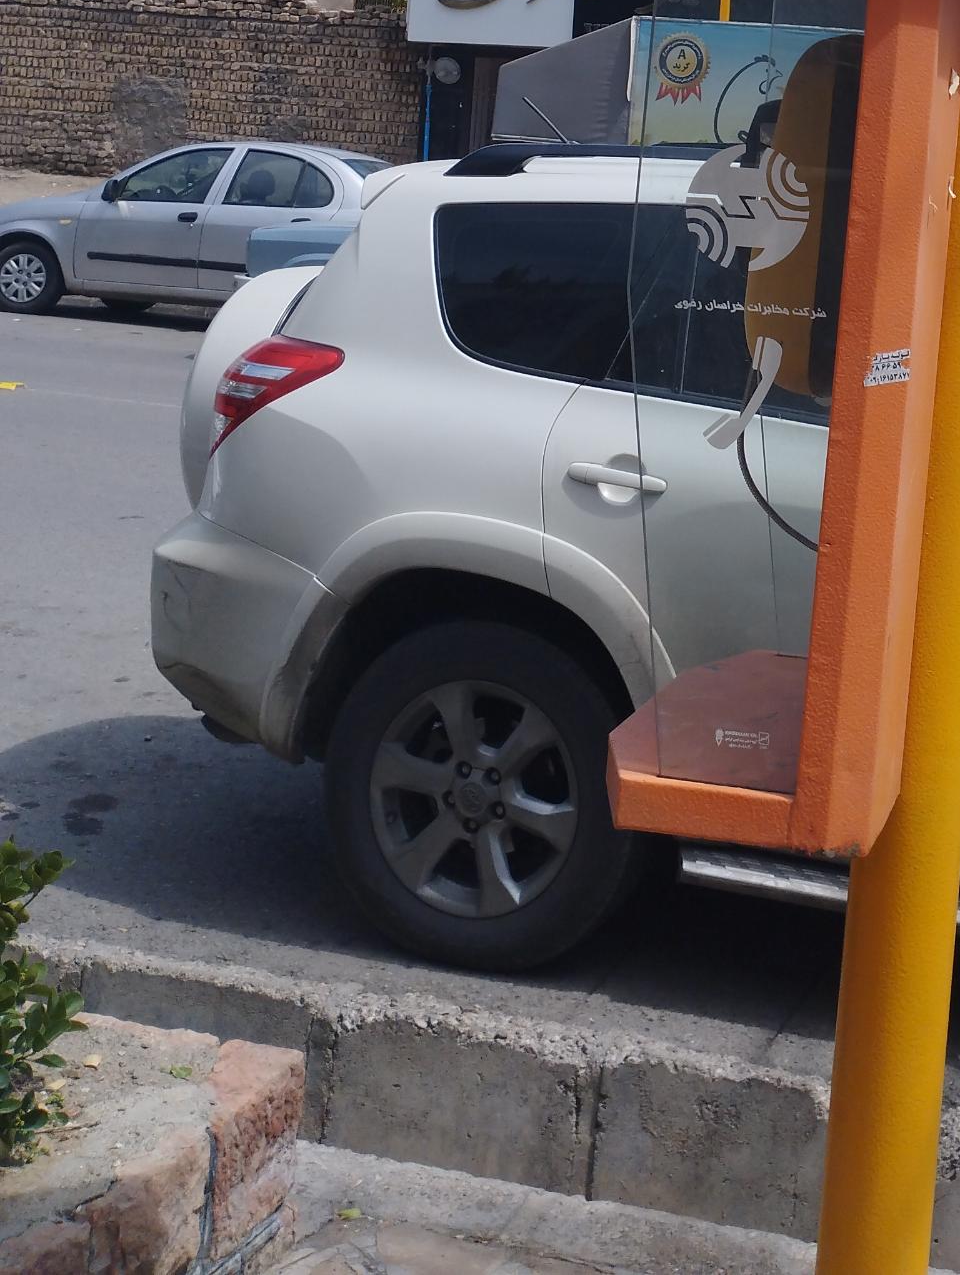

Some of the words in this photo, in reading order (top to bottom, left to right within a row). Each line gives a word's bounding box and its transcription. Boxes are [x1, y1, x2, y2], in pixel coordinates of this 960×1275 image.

[677, 48, 687, 60] A
[674, 298, 703, 311] رضوی
[705, 299, 745, 313] خراسان
[746, 302, 790, 316] مخابرات
[791, 306, 827, 319] شرکت
